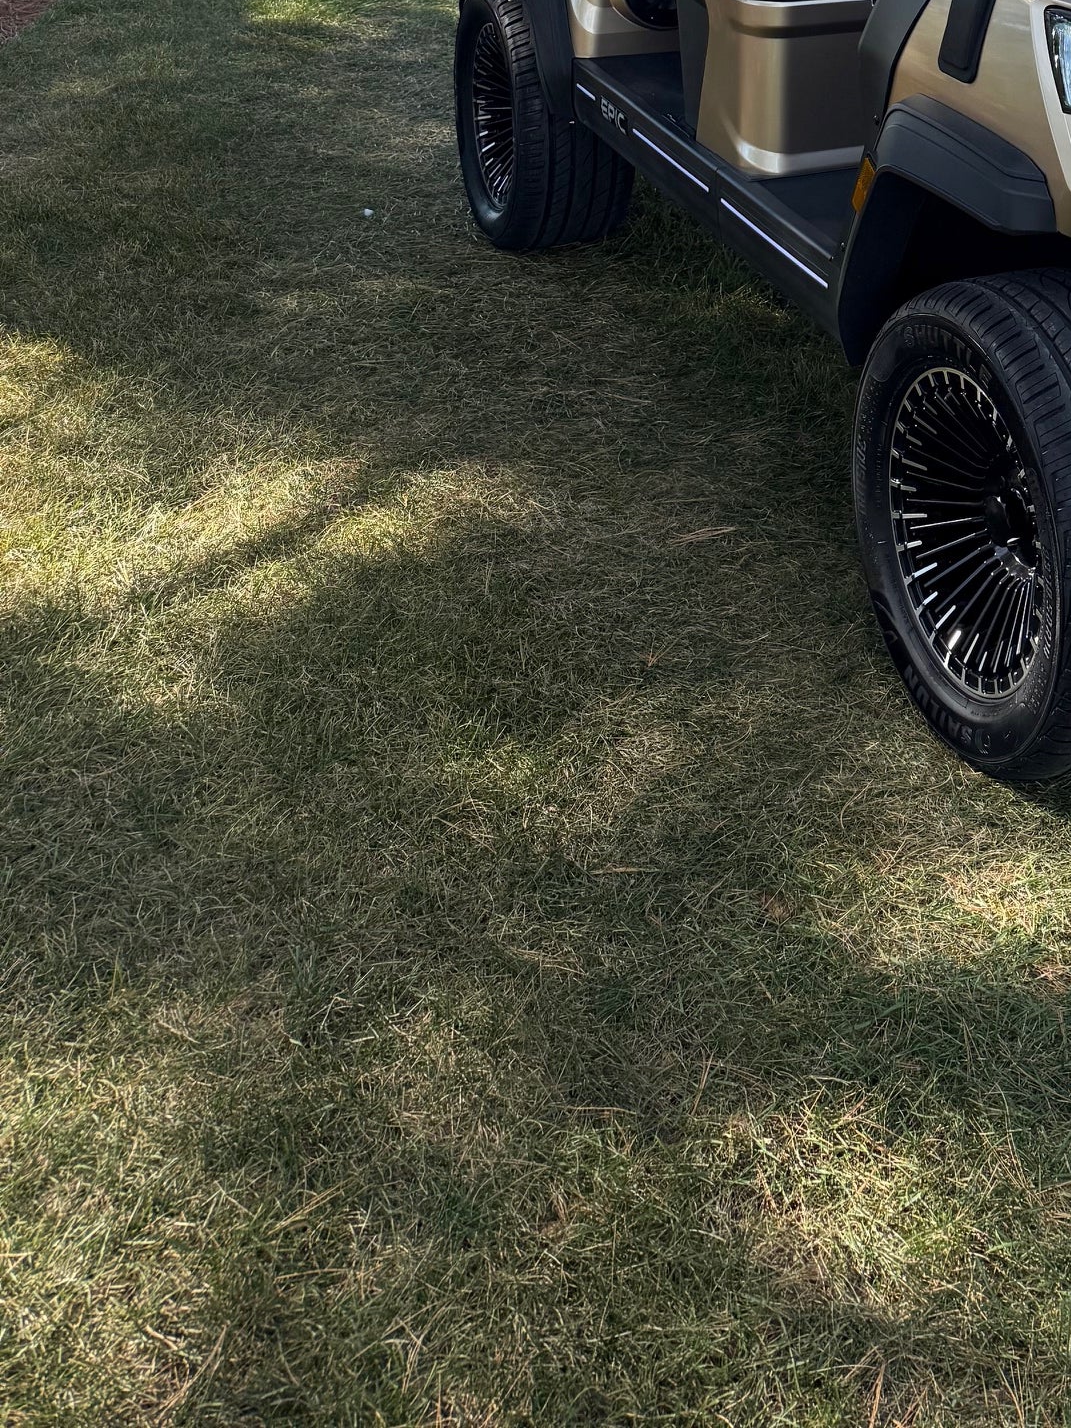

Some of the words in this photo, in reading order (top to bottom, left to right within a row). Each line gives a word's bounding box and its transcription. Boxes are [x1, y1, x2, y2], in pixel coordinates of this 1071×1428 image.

[600, 97, 627, 135] EPIC
[903, 323, 993, 391] SHUTTLE
[901, 663, 974, 747] SAILUN
